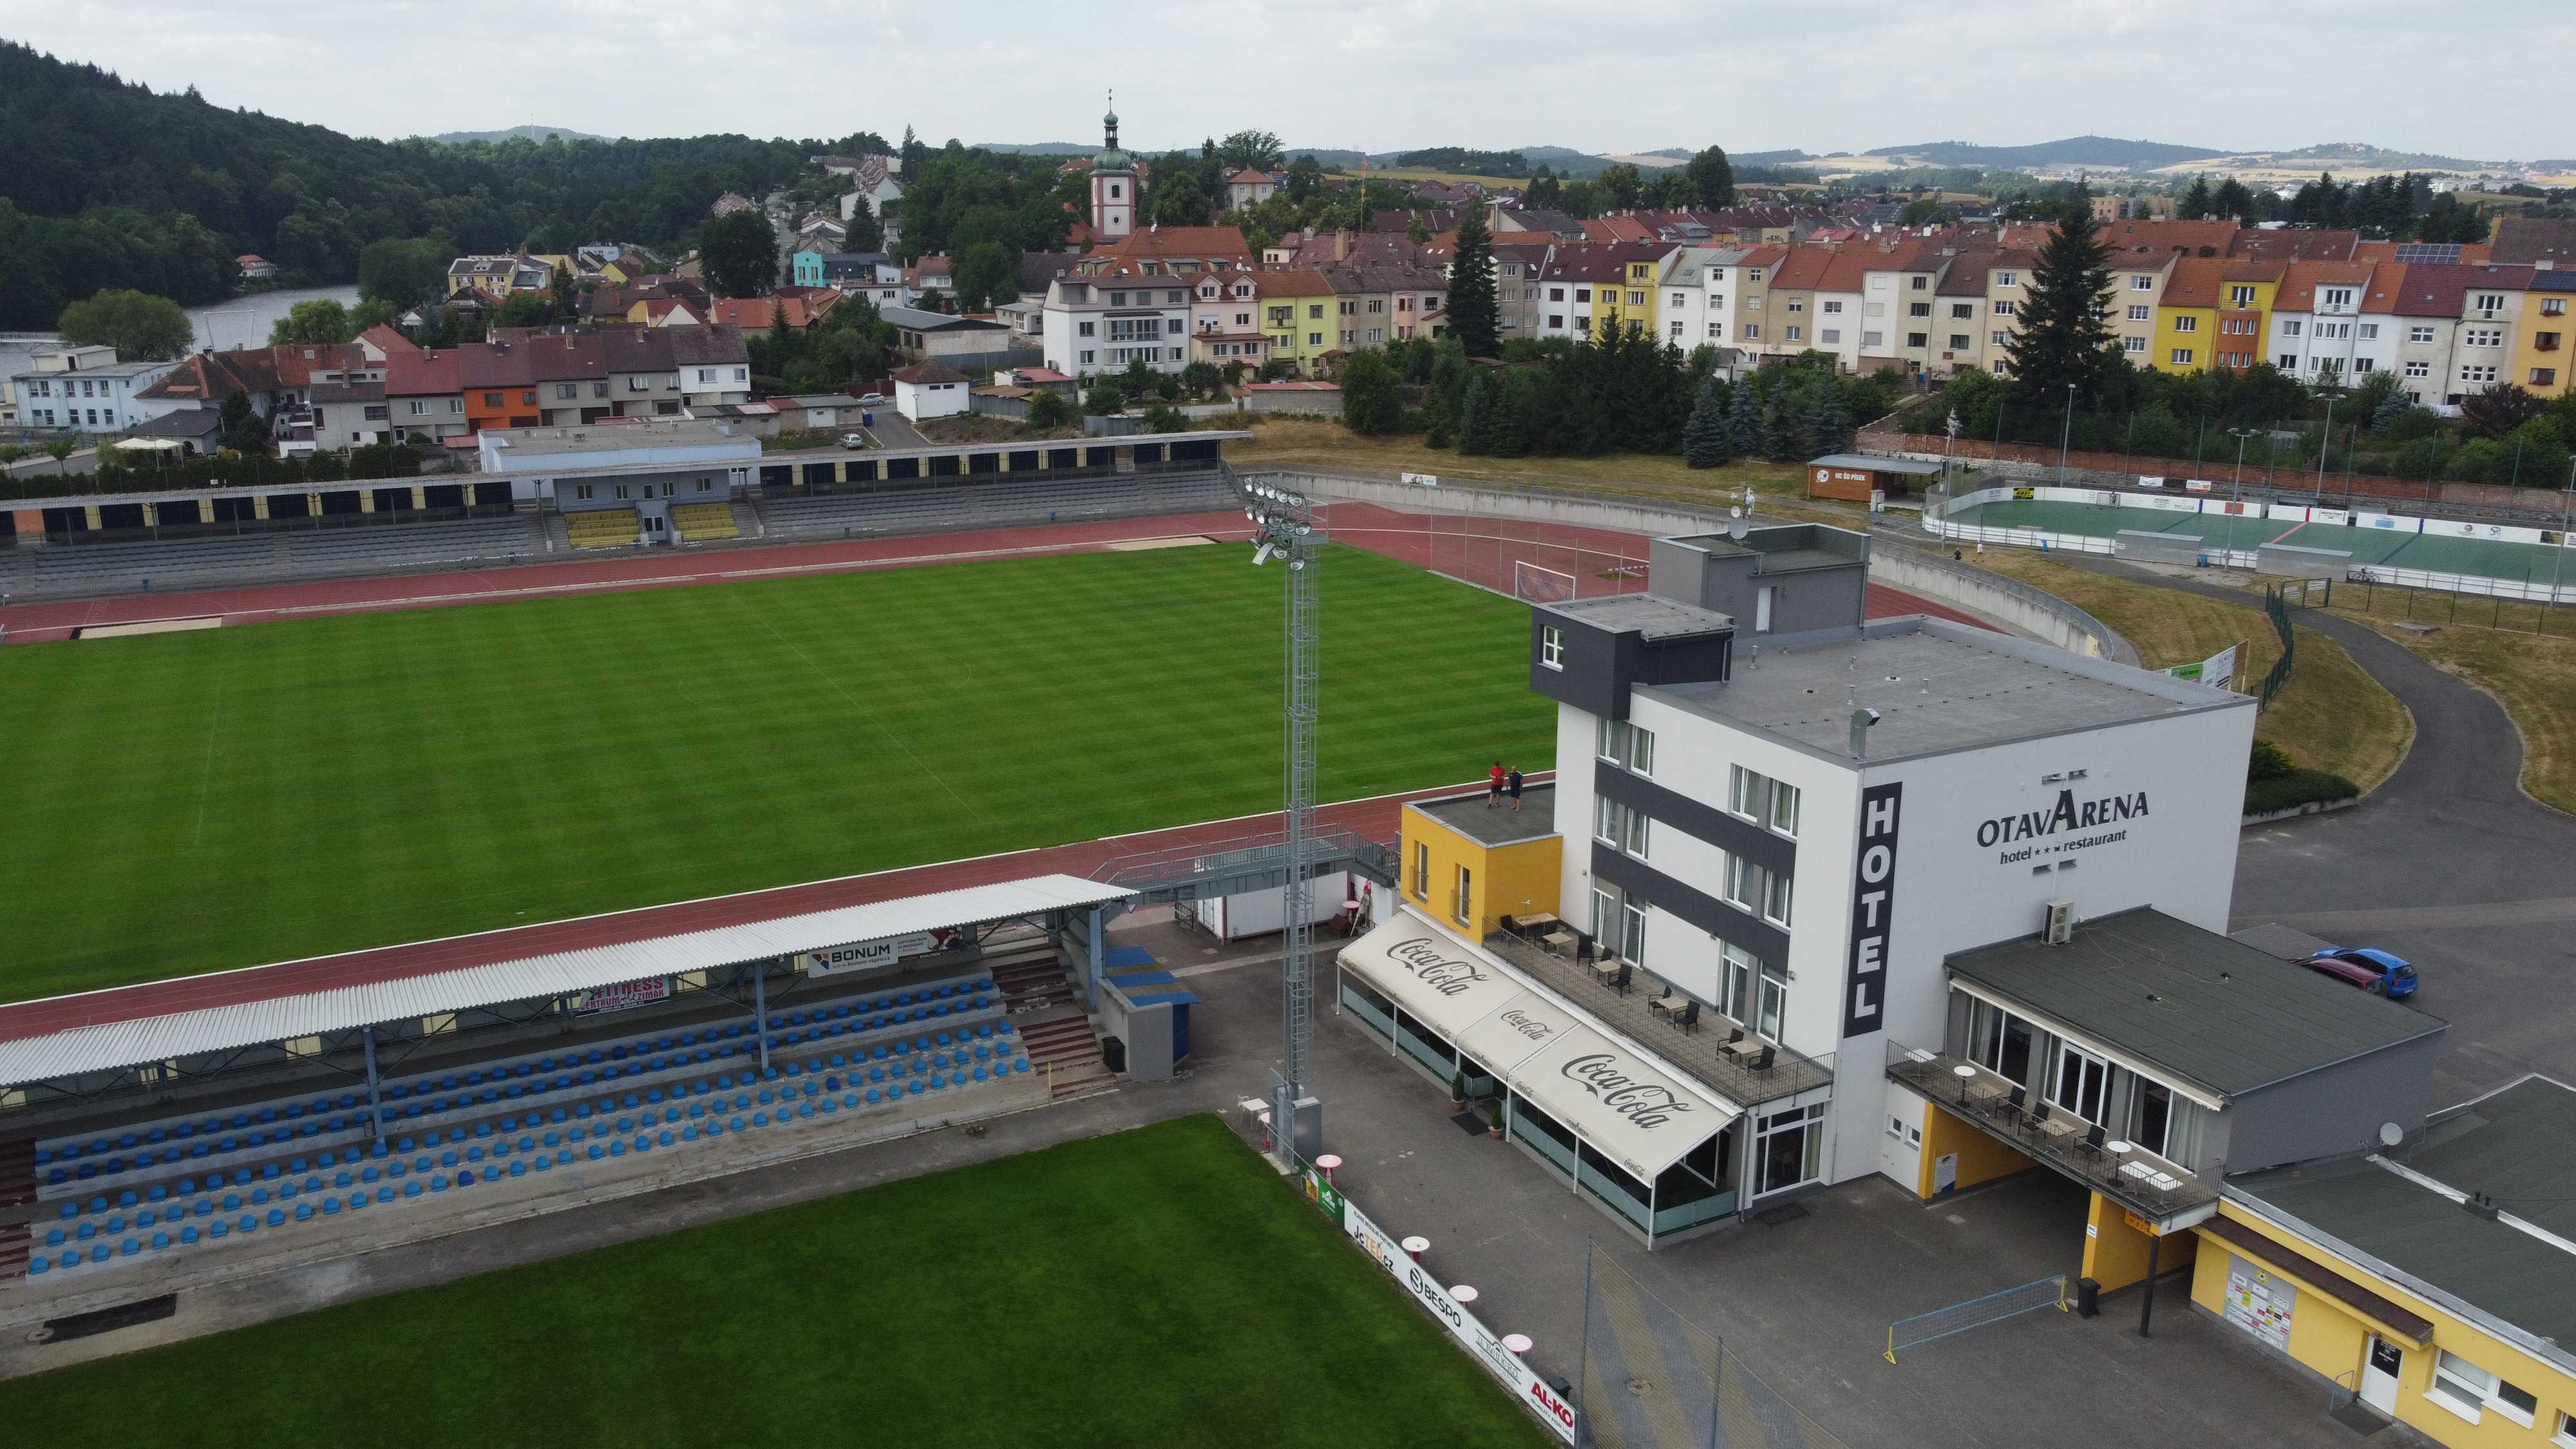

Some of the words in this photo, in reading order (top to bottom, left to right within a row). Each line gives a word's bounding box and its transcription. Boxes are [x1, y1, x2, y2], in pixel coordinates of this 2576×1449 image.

[2000, 846, 2031, 864] hotel
[2063, 829, 2127, 852] restaurant
[1854, 797, 1895, 1018] HOTEL
[831, 943, 890, 963] BONUM
[1387, 938, 1492, 996] Coca-Cola
[597, 978, 663, 998] FITNESS
[1501, 1010, 1555, 1040] Coca-Cola
[1561, 1054, 1695, 1129] Coca-Cola
[1425, 1284, 1461, 1328] BESPO
[1531, 1381, 1573, 1428] AL-KO
